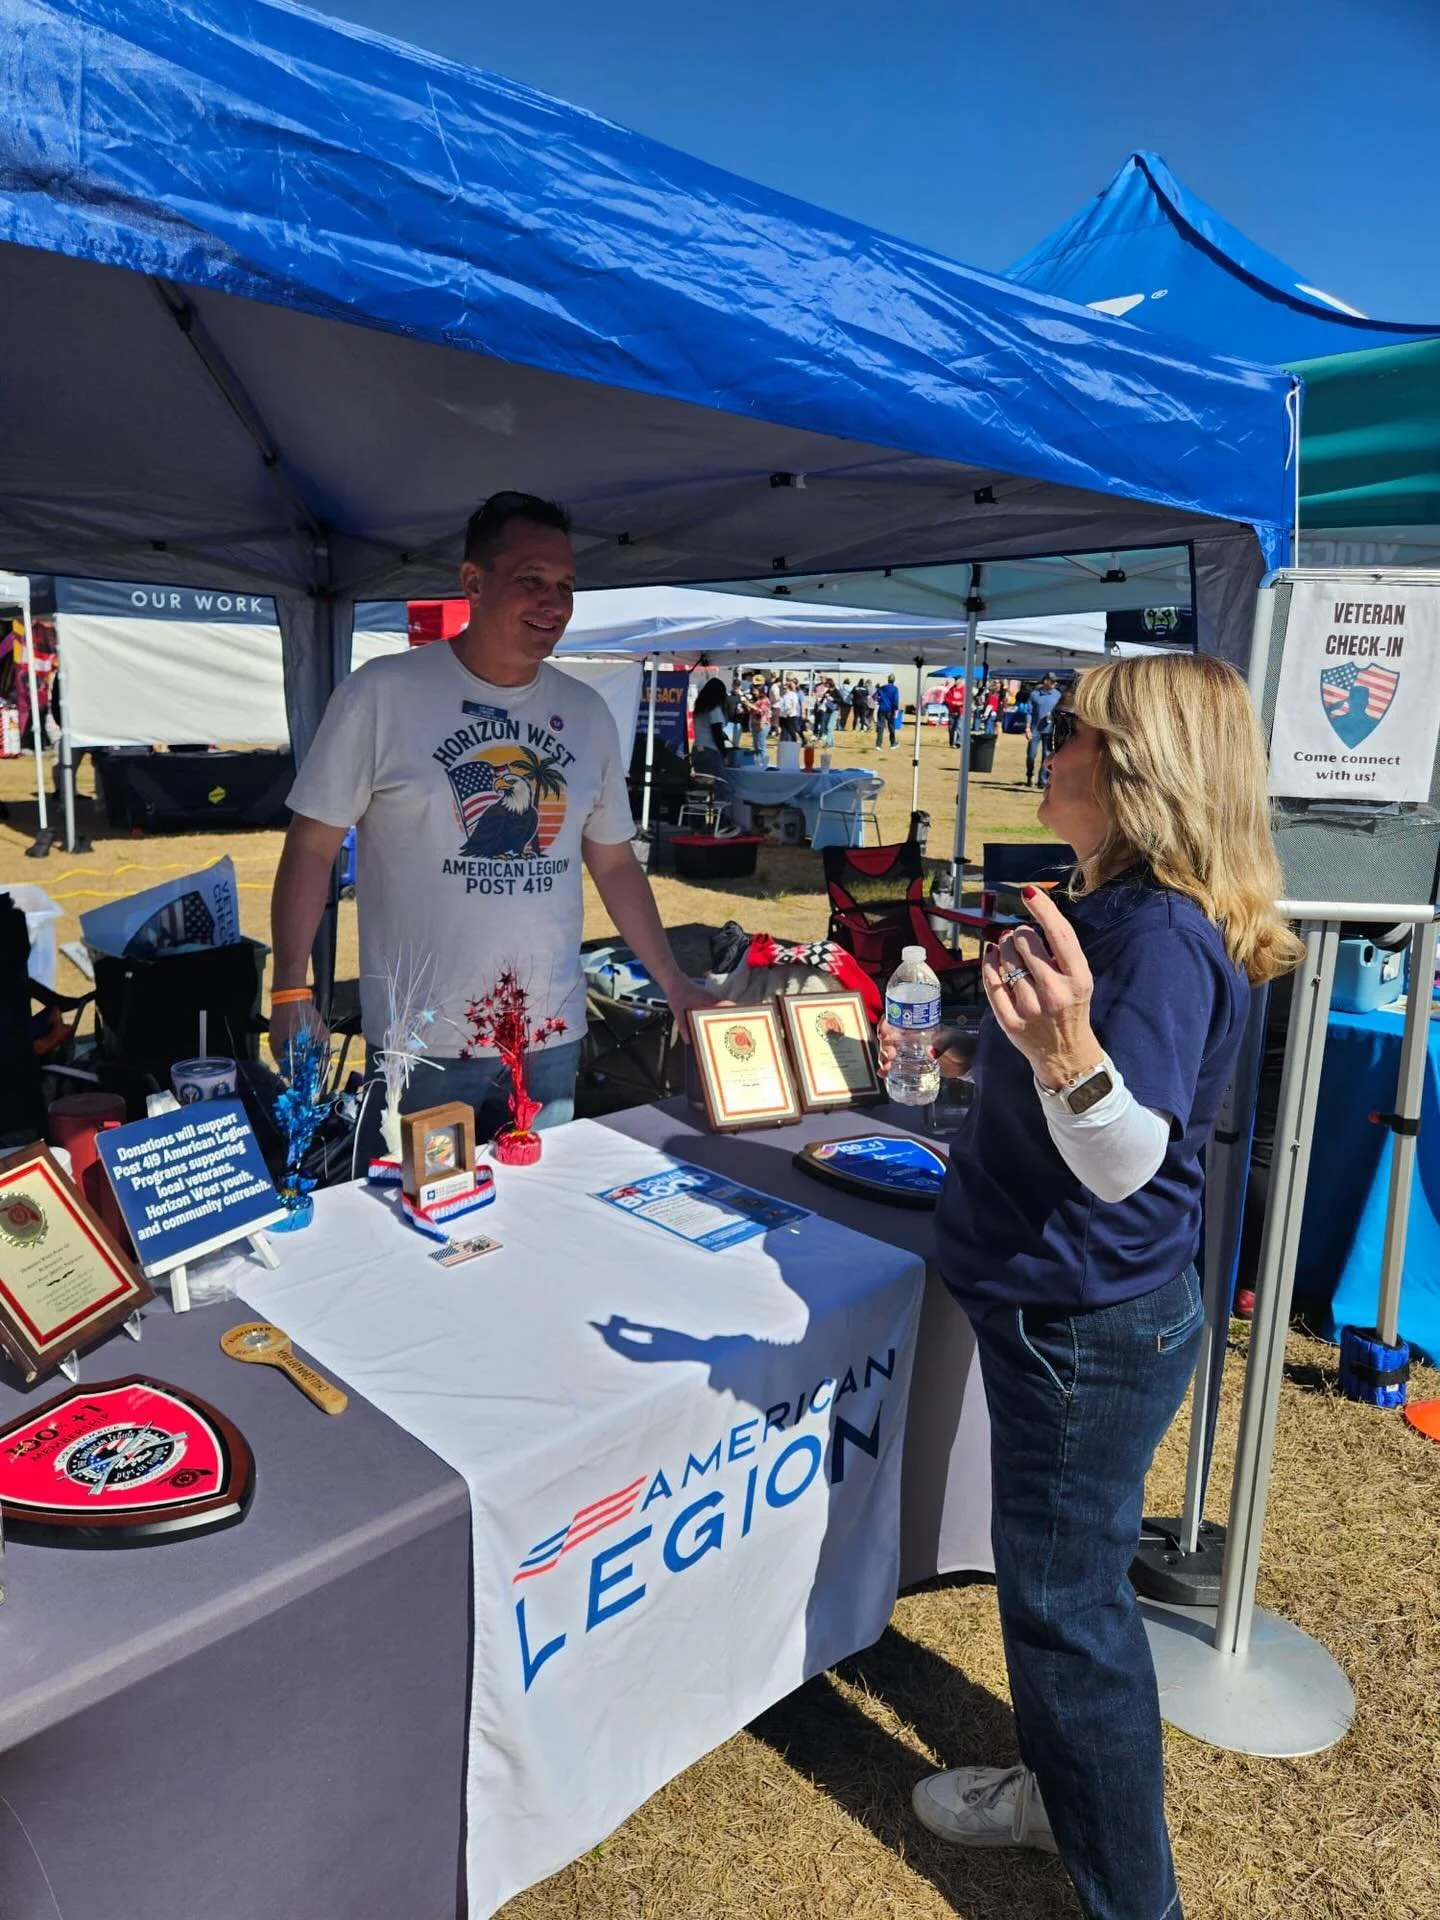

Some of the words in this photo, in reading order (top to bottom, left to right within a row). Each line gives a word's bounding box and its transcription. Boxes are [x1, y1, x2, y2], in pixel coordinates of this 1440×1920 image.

[131, 590, 182, 609] OUR
[194, 594, 262, 613] WORK
[1333, 602, 1406, 625] VETERAN
[1325, 634, 1404, 657] CHECK-IN
[432, 718, 520, 768] HORIZON
[527, 723, 576, 768] WEST
[1294, 751, 1337, 763] Come
[1341, 752, 1401, 765] connect
[1315, 770, 1351, 782] with
[1354, 771, 1377, 783] us!
[442, 858, 524, 878] AMERICAN
[528, 857, 570, 876] LEGION
[465, 877, 516, 895] POST
[523, 877, 553, 894] 419
[113, 1163, 142, 1181] Post
[142, 1154, 161, 1169] 419
[163, 1137, 216, 1163] American
[215, 1124, 251, 1145] Legion
[117, 1134, 175, 1162] Donations
[175, 1124, 196, 1142] will
[197, 1112, 238, 1136] support
[131, 1162, 188, 1191] Programs
[188, 1140, 247, 1170] supporting
[155, 1177, 185, 1199] local
[185, 1162, 235, 1188] veterans,
[145, 1195, 191, 1220] Horizon
[190, 1183, 222, 1202] West
[615, 1173, 711, 1209] BLOOD
[137, 1224, 161, 1241] and
[162, 1199, 223, 1230] community
[223, 1179, 271, 1206] outreach.
[640, 1348, 896, 1513] AMERICAN
[515, 1400, 882, 1694] LEGION
